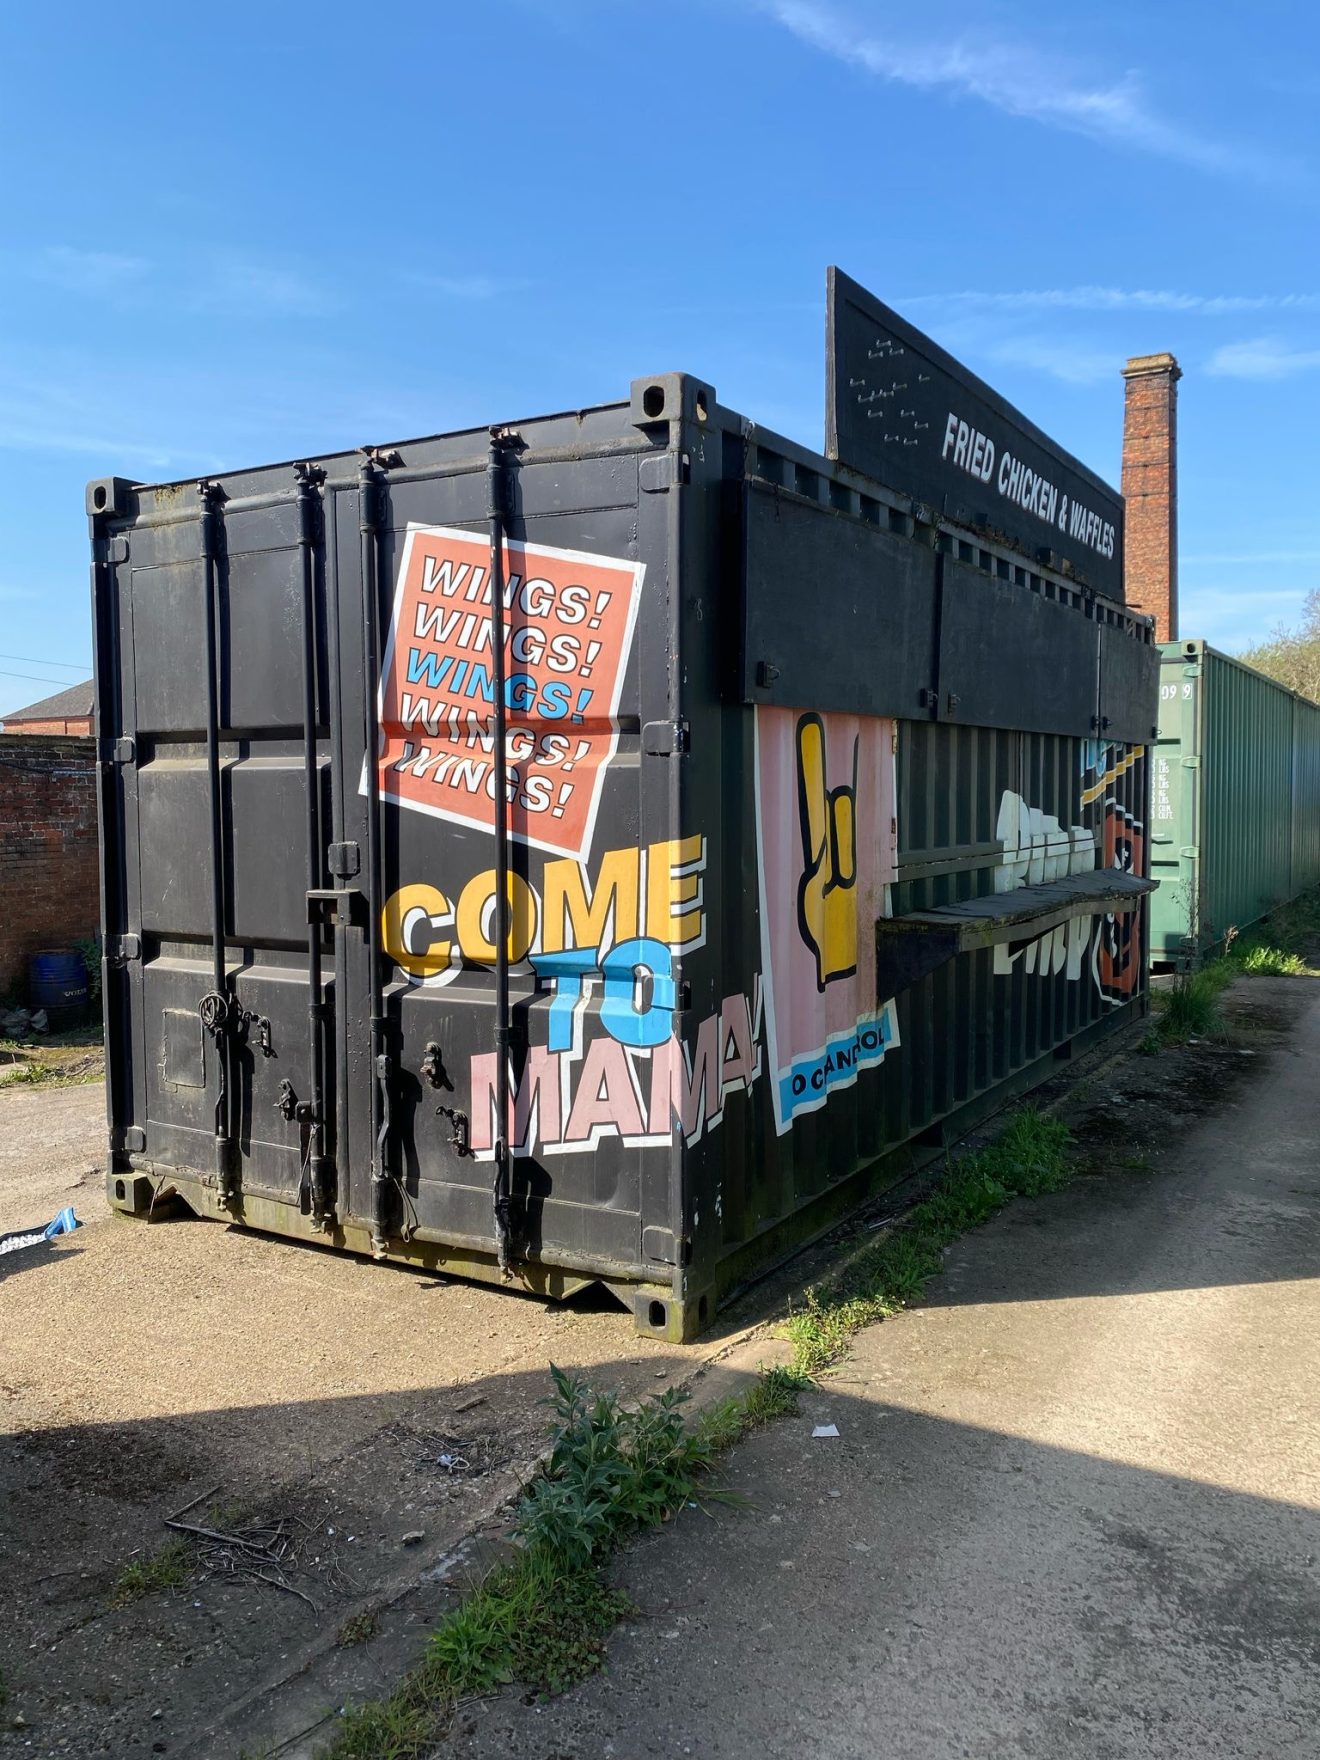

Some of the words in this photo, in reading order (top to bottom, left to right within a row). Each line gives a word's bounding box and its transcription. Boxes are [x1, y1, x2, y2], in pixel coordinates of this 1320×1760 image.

[941, 412, 995, 485] FRIED
[998, 451, 1058, 526] CHICKEN
[1058, 494, 1067, 530] &
[1069, 500, 1115, 561] WAFFLES
[421, 555, 613, 630] WINGS!
[413, 601, 603, 678] WINGS!
[406, 647, 595, 725] WINGS!
[400, 693, 592, 772] WINGS!
[393, 742, 575, 819] WINGS!
[381, 833, 705, 981] COME
[528, 937, 676, 1053] TO
